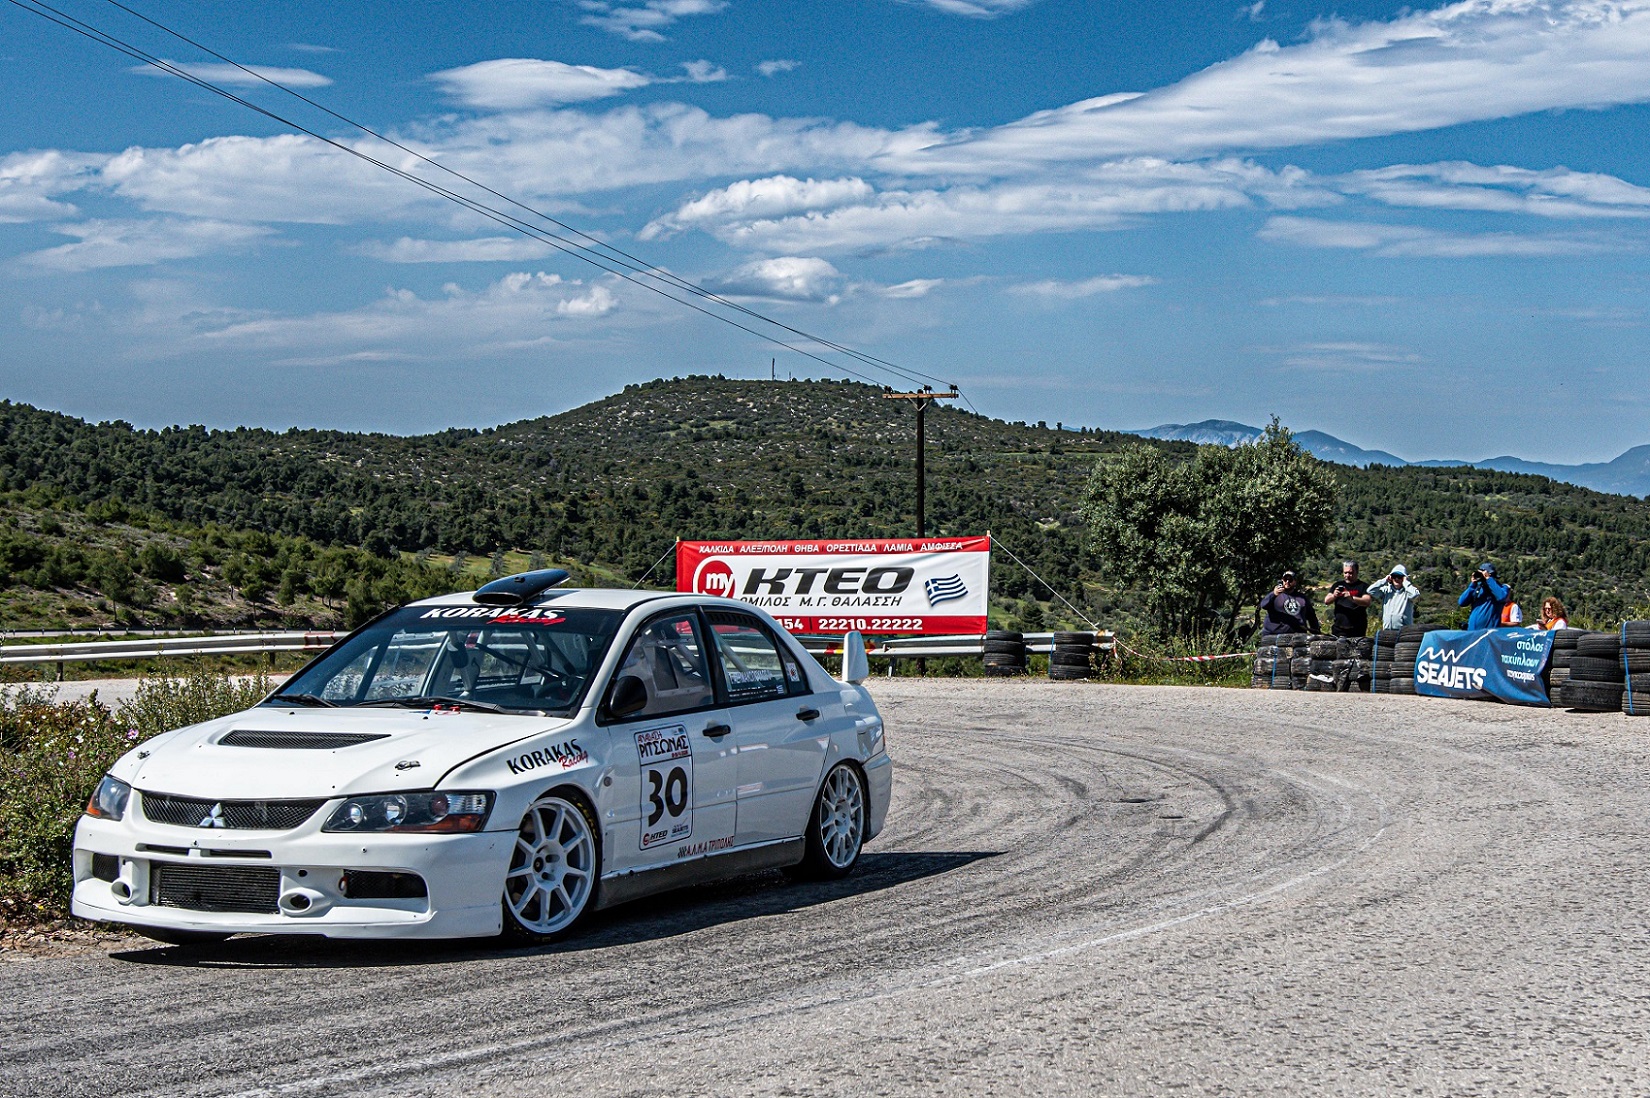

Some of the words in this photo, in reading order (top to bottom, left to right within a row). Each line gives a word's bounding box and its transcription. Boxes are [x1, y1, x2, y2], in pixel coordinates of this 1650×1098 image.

[699, 544, 735, 554] ΧΑΛΚΙΔΑ
[794, 544, 819, 553] ΘΗΒΑ
[826, 543, 877, 552] ΟΡΕΣΤΙΑΔΑ
[883, 543, 914, 552] ΛΑΜΙΑ
[919, 541, 963, 552] ΑΜΦΙΣΣΑ
[742, 566, 915, 595] ΚΤΕΟ
[831, 596, 903, 607] ΘΑΛΑΣΣΗ
[420, 607, 565, 619] KORAKAS
[818, 618, 923, 631] 22210.22222
[1516, 638, 1544, 652] στόλος
[1416, 660, 1487, 690] SEAJETS
[639, 735, 688, 757] ΡΙΤΣΩΝΑΣ
[506, 738, 583, 775] KORAKAS
[558, 750, 589, 770] Racing
[648, 766, 688, 828] 30
